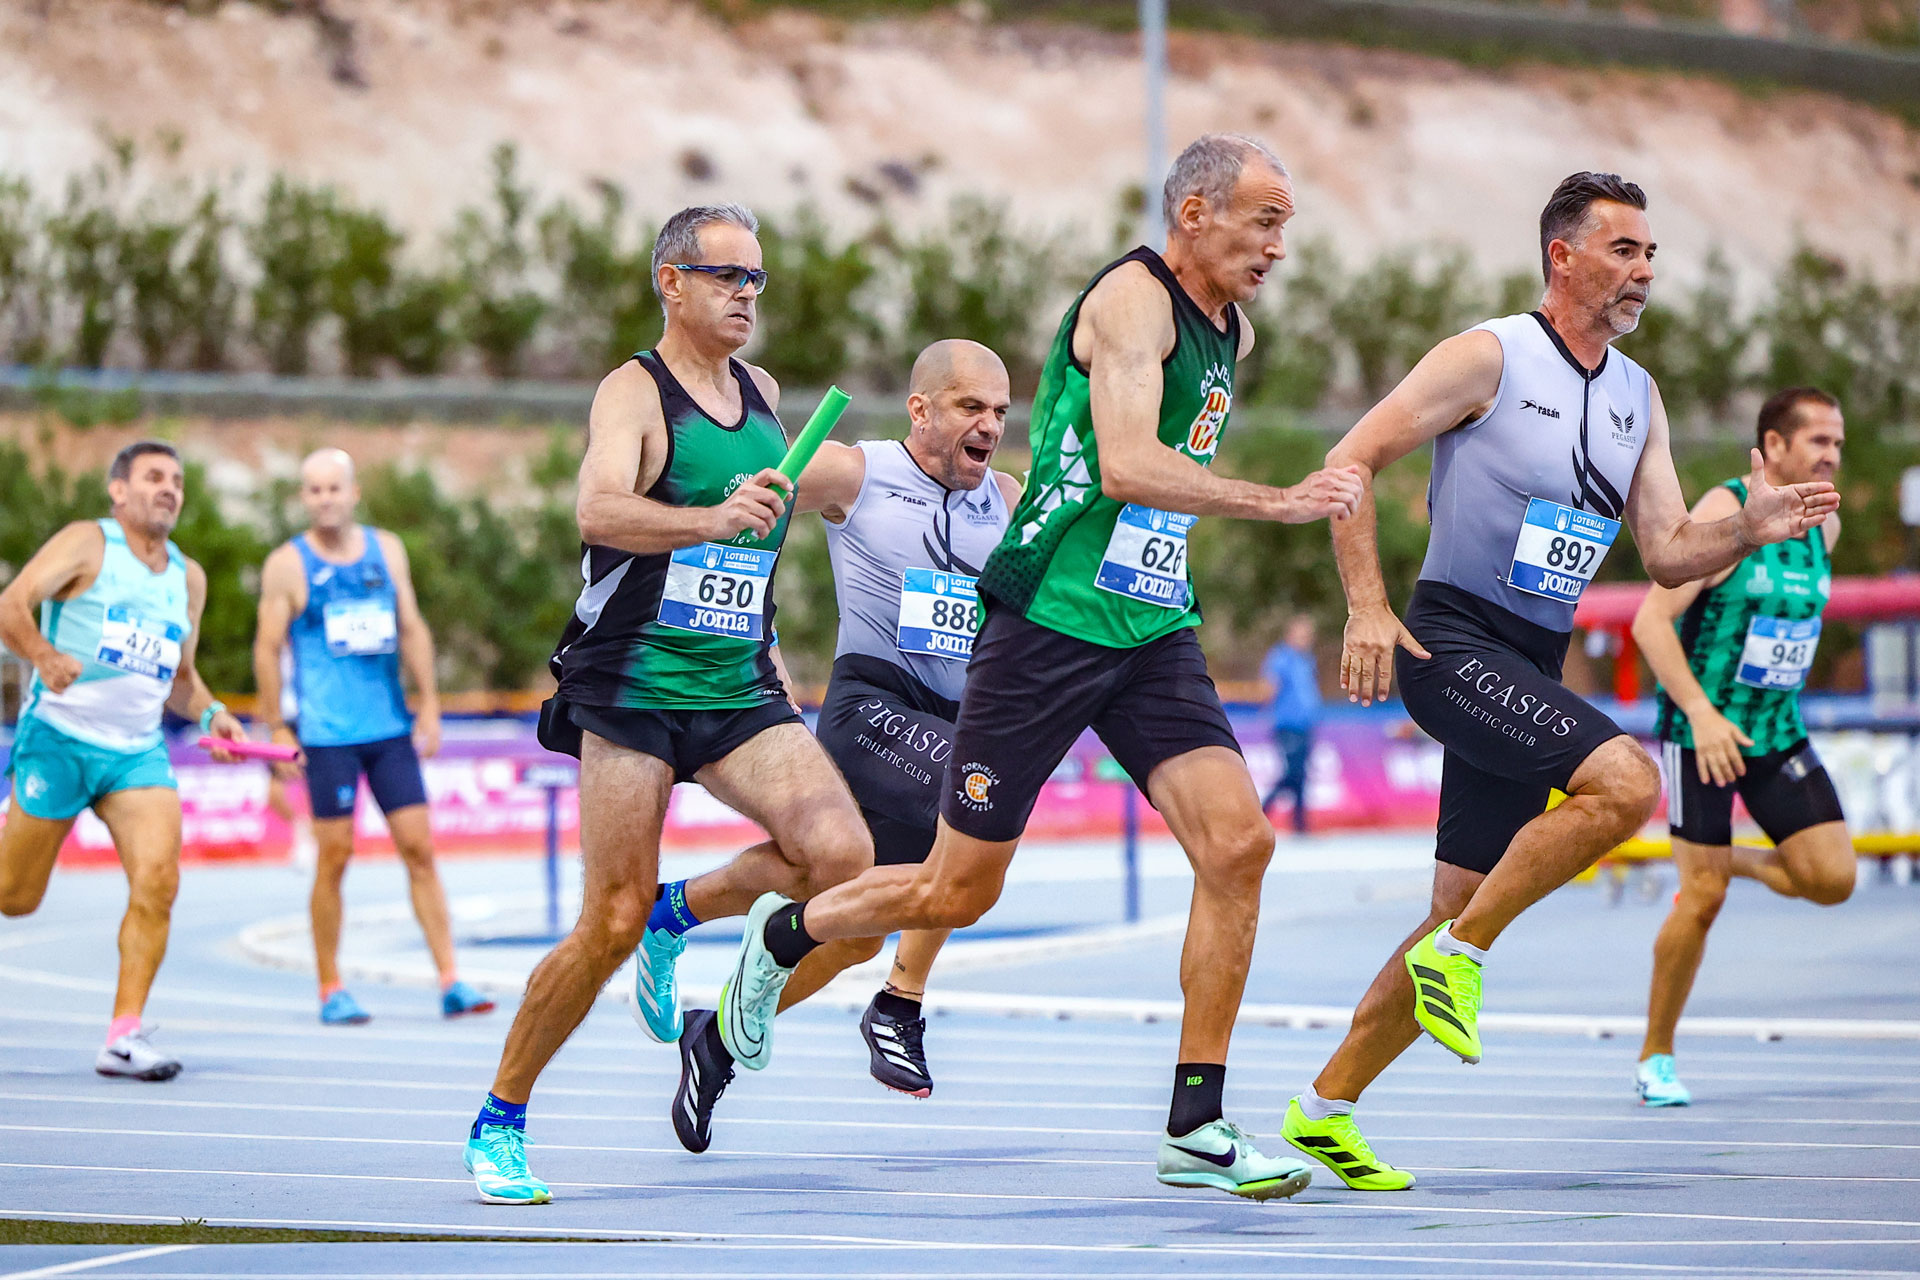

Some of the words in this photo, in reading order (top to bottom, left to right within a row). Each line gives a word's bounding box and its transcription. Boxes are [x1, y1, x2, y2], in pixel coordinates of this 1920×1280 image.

[1538, 405, 1560, 419] rasán
[1611, 431, 1636, 444] PEGASUS
[1572, 514, 1605, 532] LOTERÍAS
[725, 551, 761, 564] LOTERÍAS
[1141, 537, 1185, 574] 626
[1547, 537, 1597, 575] 892
[699, 574, 754, 609] 630
[932, 599, 978, 633] 888
[858, 699, 952, 769] PEGASU
[1441, 686, 1501, 730] ATHLETIC
[1501, 724, 1537, 748] CLUB
[854, 733, 905, 769] ATHLETIC
[904, 762, 933, 785] CLUB
